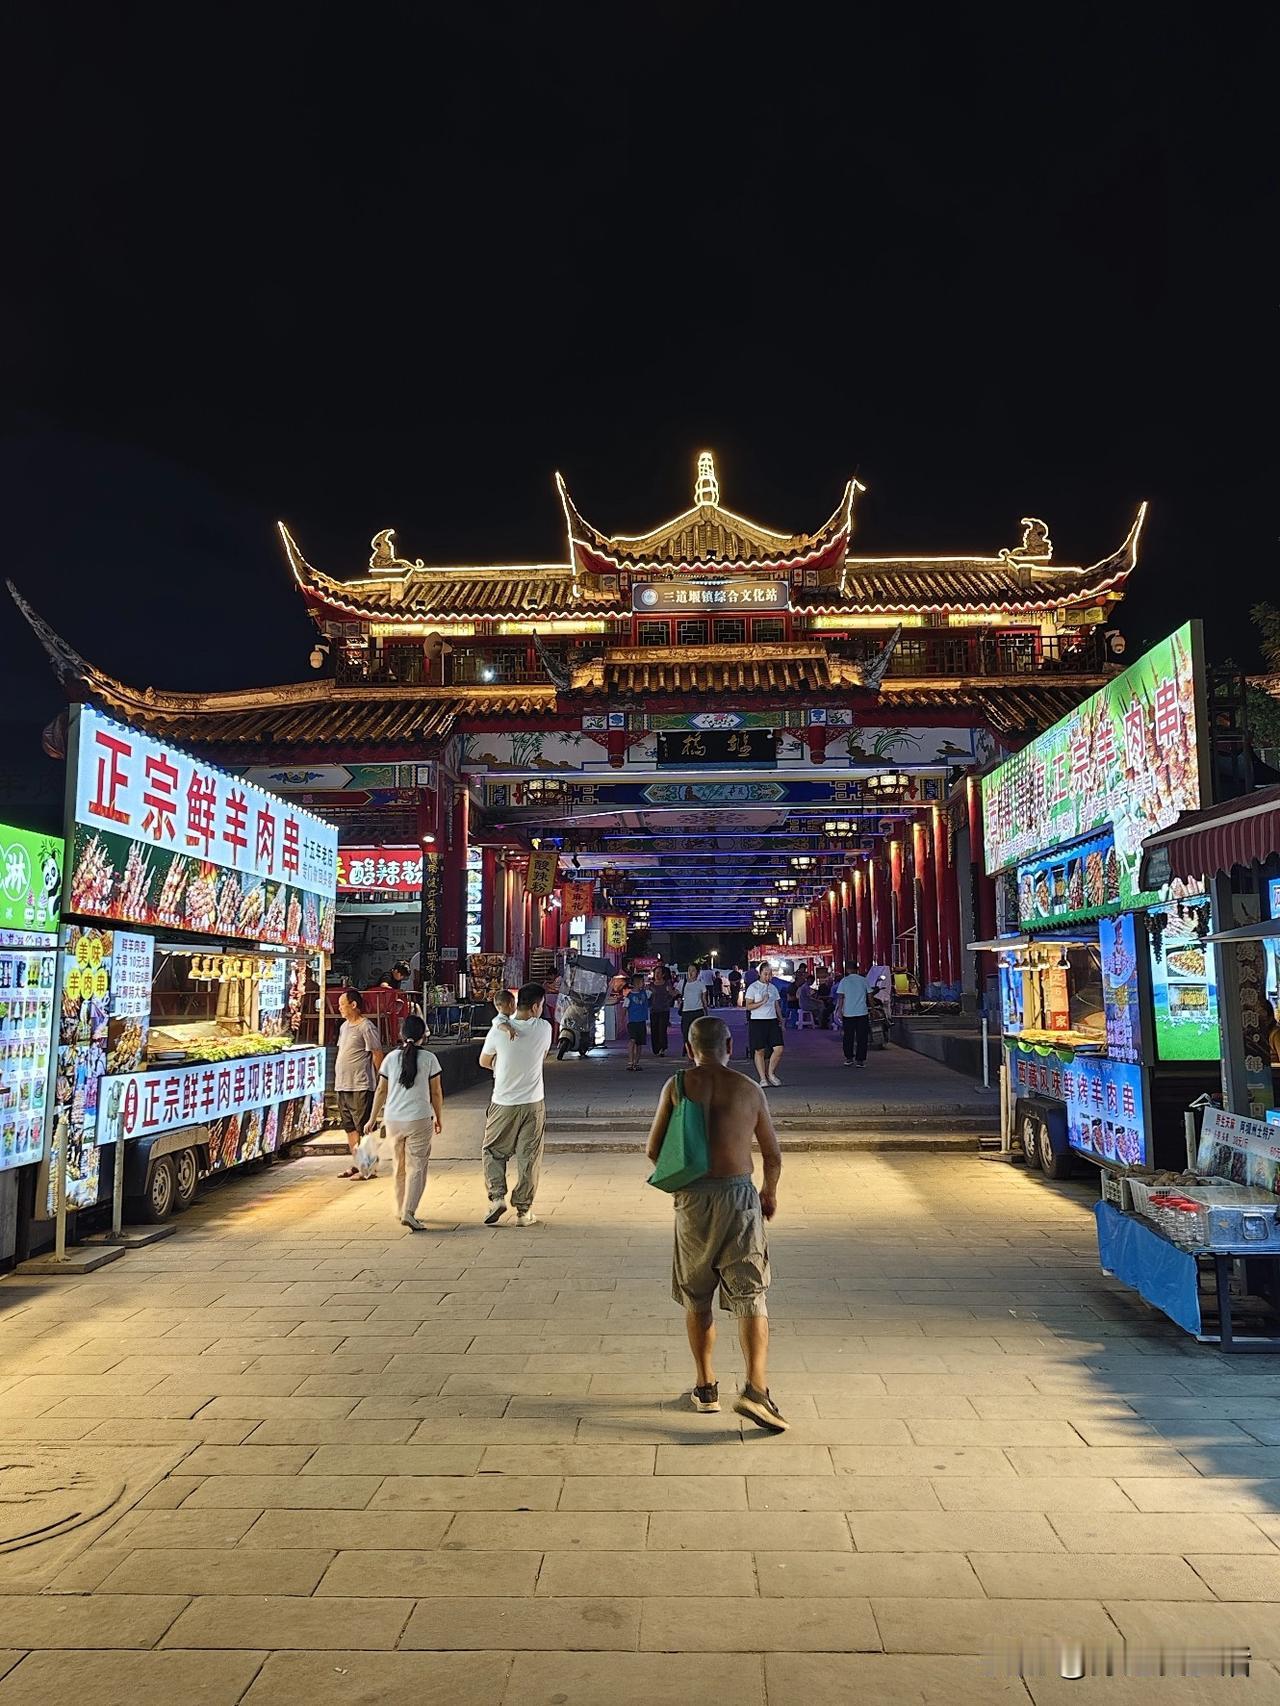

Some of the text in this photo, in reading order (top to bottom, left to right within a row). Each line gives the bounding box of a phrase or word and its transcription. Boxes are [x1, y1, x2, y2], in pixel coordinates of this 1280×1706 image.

[663, 588, 778, 604] 三道堰镇综合文化站
[88, 729, 300, 882] 正宗鲜羊肉串
[531, 859, 550, 893] 酸辣粉
[79, 941, 102, 965] 美味
[69, 972, 105, 995] 羊肉串
[142, 1056, 316, 1128] 正宗鲜羊肉串现烤现串现卖
